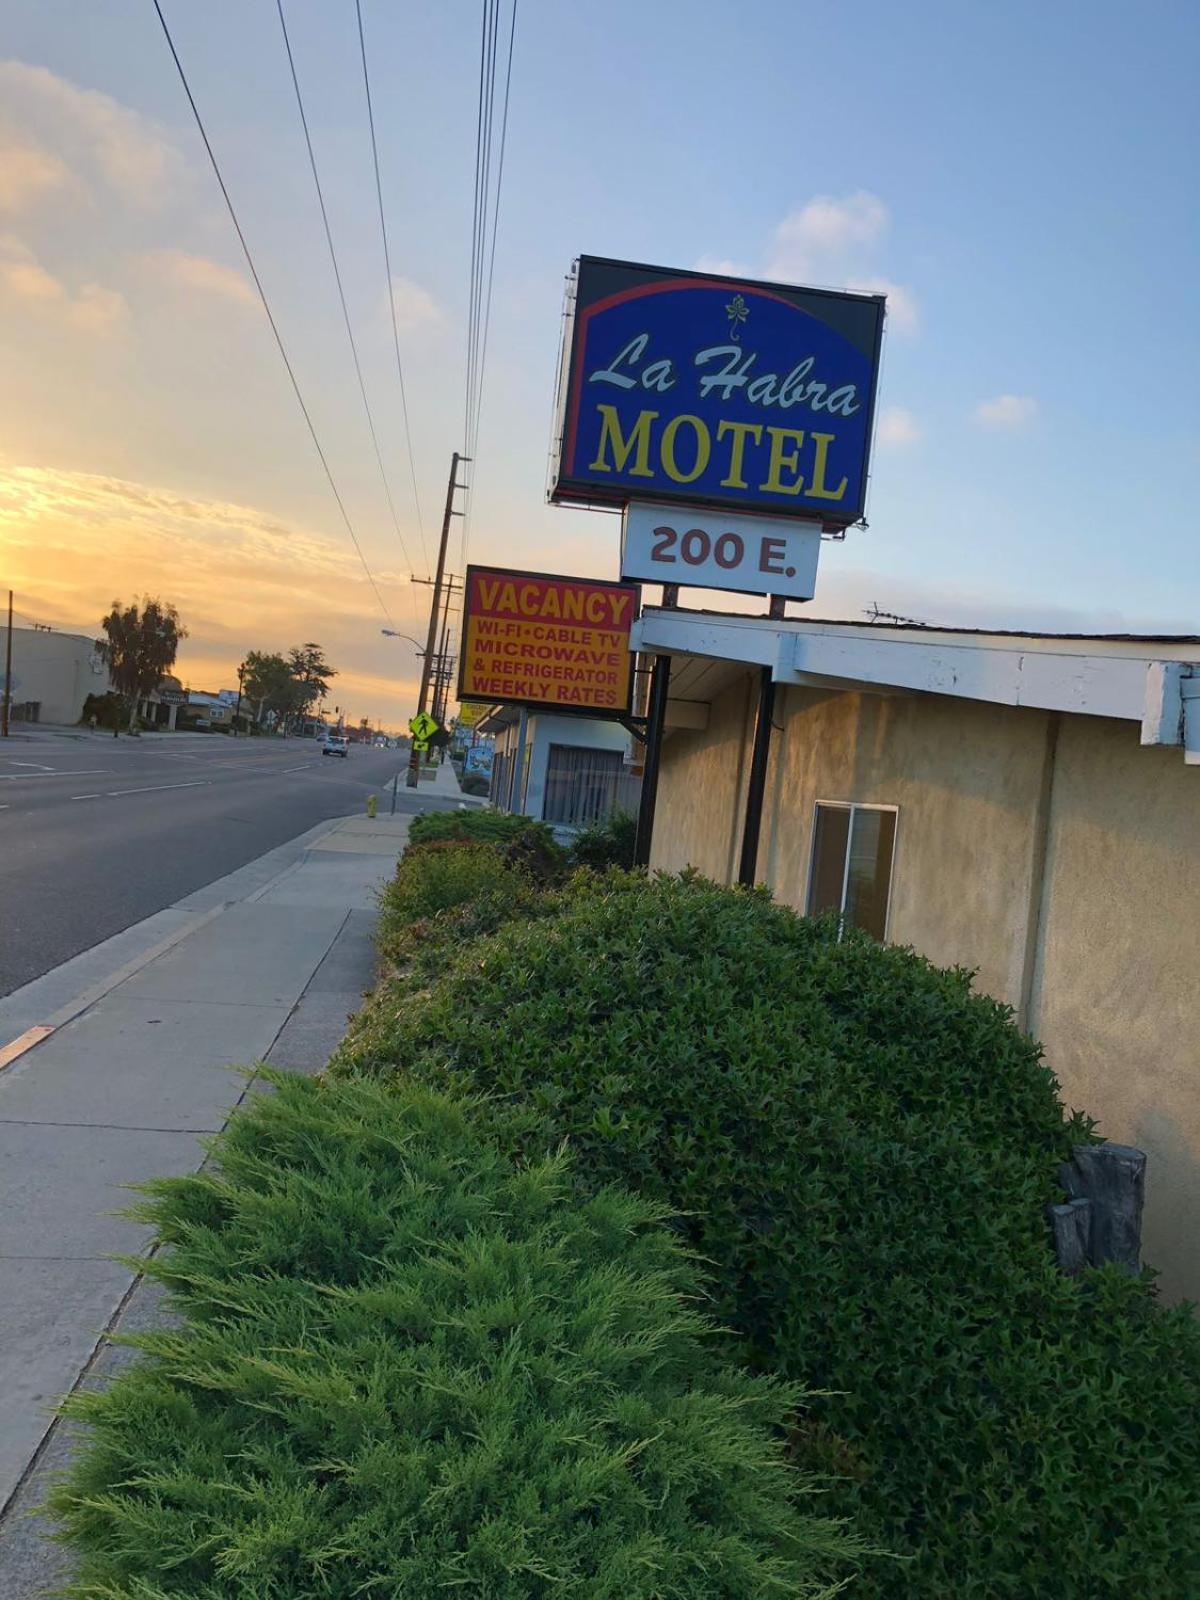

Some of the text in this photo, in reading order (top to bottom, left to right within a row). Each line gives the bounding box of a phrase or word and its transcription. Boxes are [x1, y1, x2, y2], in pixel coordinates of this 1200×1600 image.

[588, 333, 861, 417] La Habra
[588, 404, 849, 501] MOTEL
[651, 526, 797, 577] 200 E.
[478, 579, 630, 625] VACANCY
[475, 638, 621, 667] MICROWAVE
[598, 633, 621, 648] TV
[473, 658, 618, 685] & REFRIGERATOR
[473, 676, 617, 705] WEEKLY RATES
